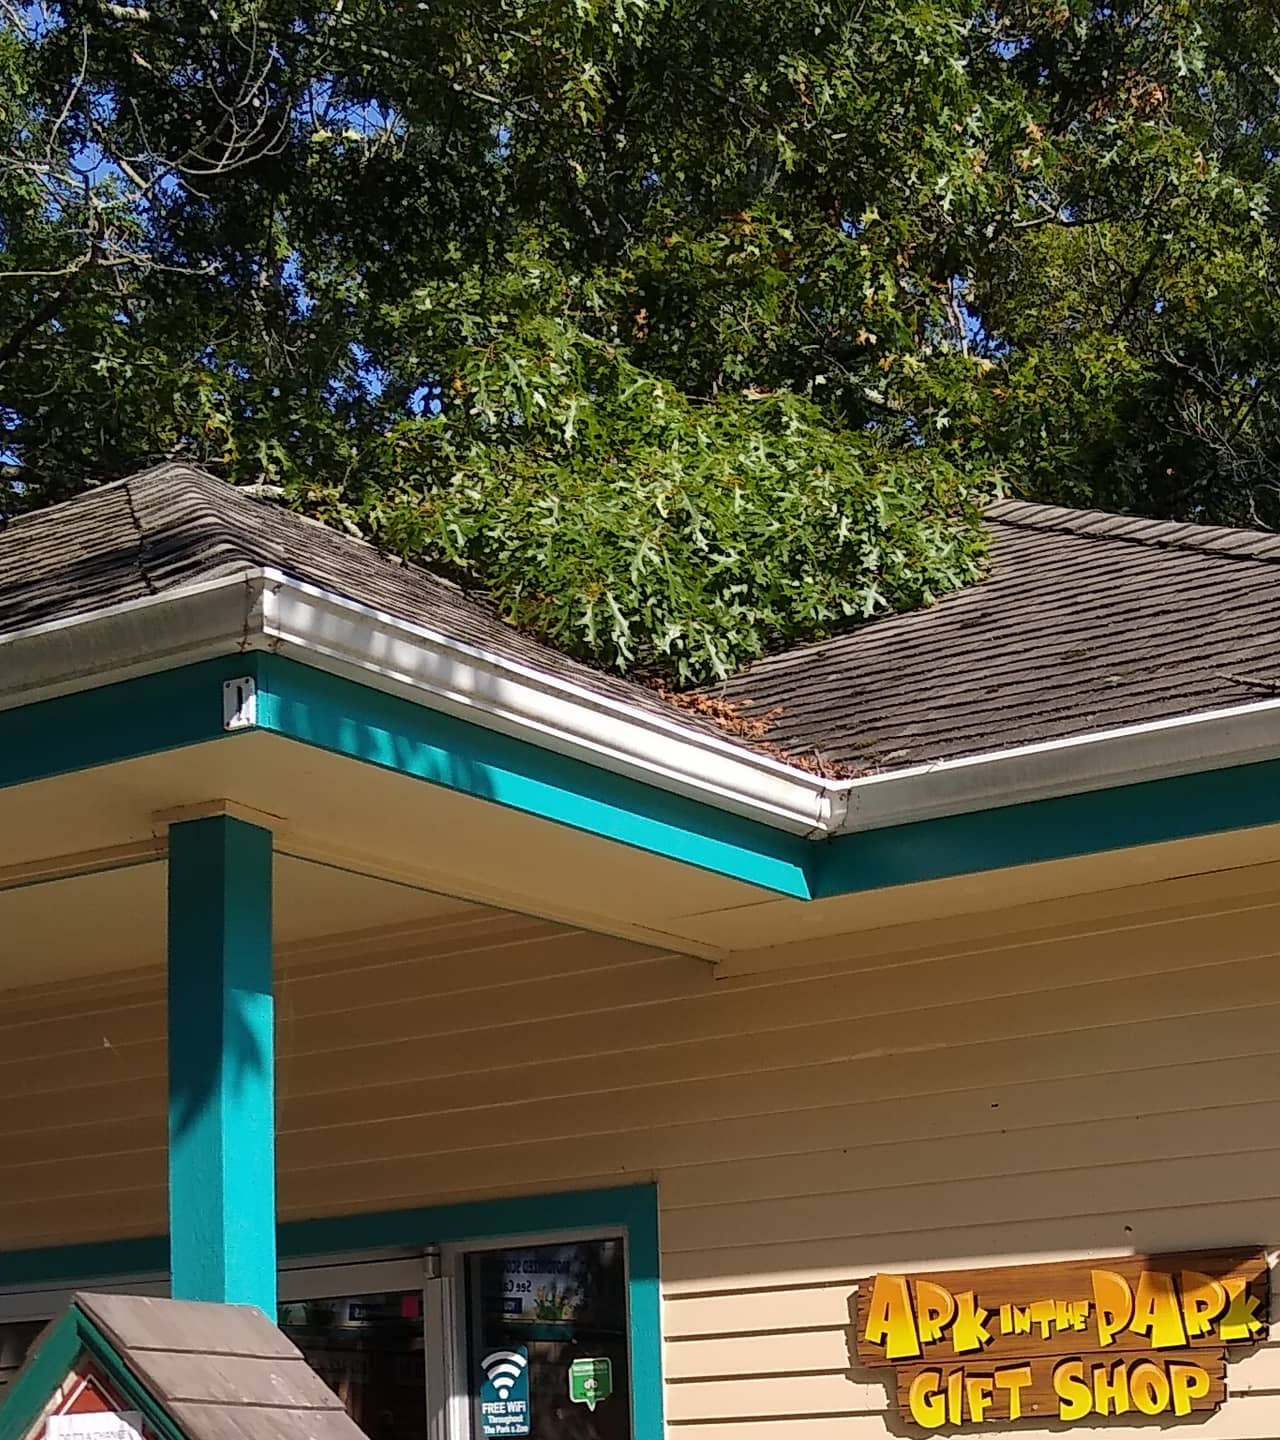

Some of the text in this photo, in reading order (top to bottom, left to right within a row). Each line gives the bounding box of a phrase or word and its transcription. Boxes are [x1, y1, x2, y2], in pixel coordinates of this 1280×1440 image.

[864, 1269, 1264, 1359] ARK IN THE PARK
[482, 1402, 506, 1414] FREE
[908, 1359, 1210, 1428] GIFT SHOP
